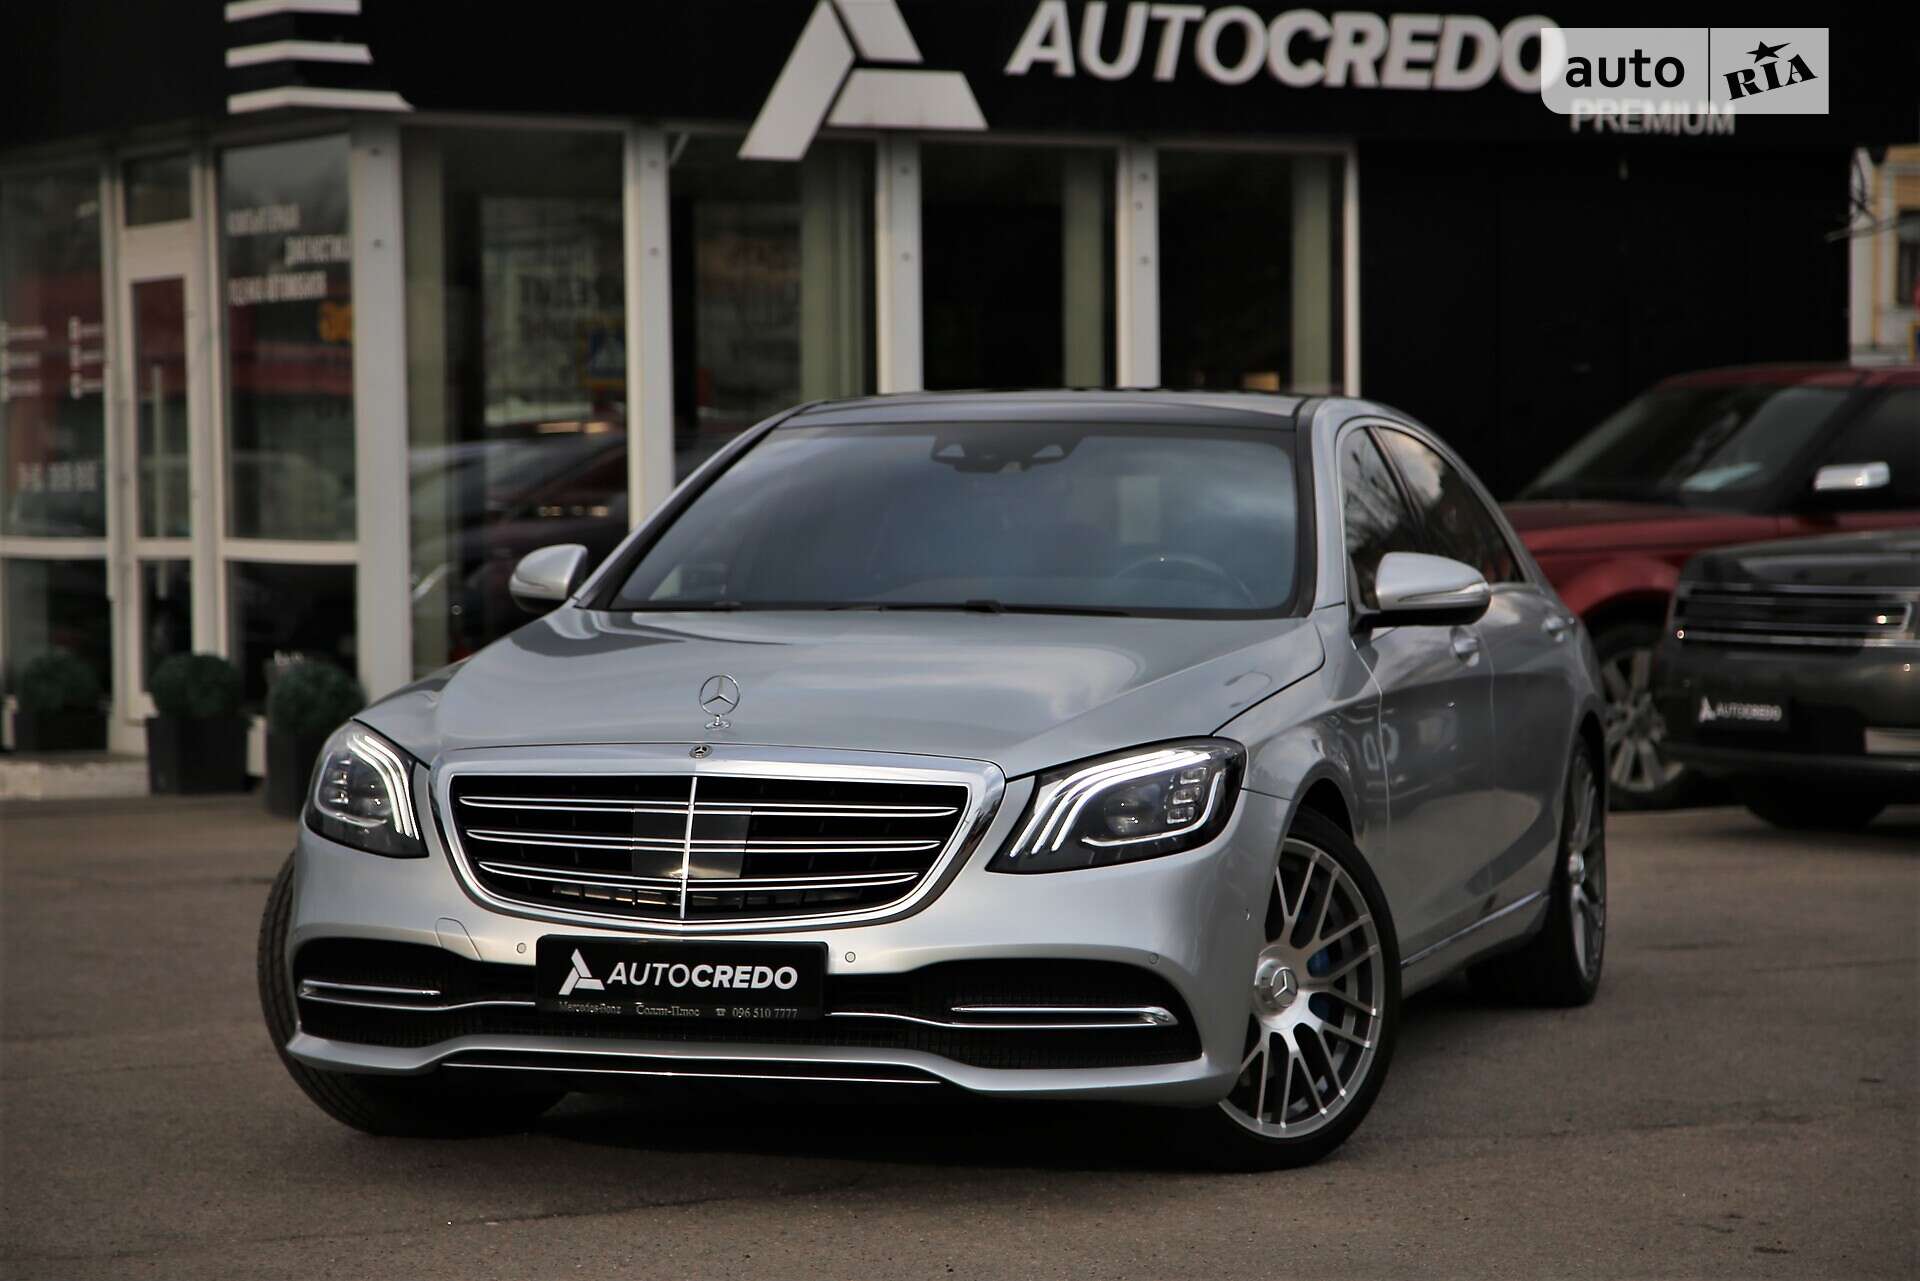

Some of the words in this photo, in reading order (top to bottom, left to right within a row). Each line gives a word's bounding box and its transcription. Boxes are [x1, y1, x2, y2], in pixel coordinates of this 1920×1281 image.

[1004, 0, 1567, 93] AUTOCREDO
[1570, 98, 1736, 135] PREMIUM
[607, 961, 798, 990] AUTOCREDO
[753, 1007, 772, 1019] 510
[774, 1008, 799, 1020] 7777
